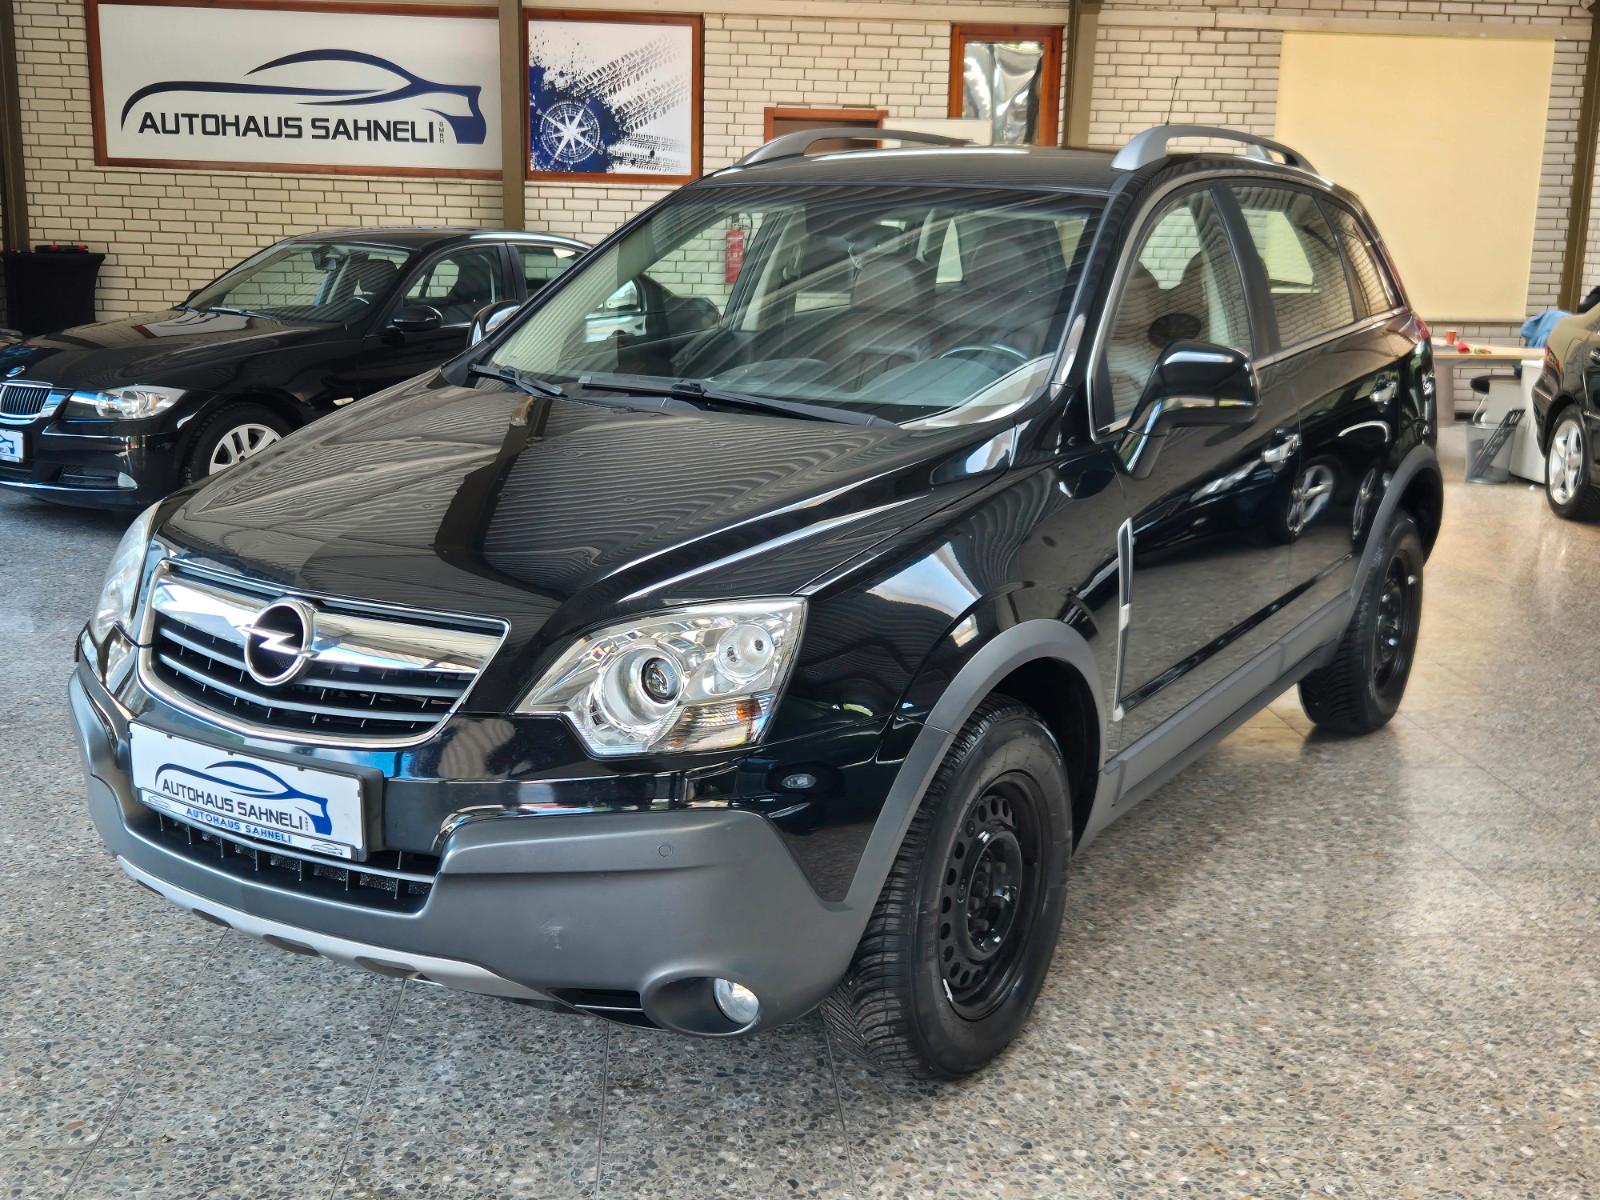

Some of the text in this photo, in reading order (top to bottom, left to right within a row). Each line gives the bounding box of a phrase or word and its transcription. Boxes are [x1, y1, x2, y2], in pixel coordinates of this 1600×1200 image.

[138, 111, 434, 144] AUTOHAUS SAHNELI
[162, 778, 234, 813] AUTOHAUS
[237, 801, 303, 830] SAHNELI
[186, 807, 292, 844] AUTOHAUS SAHNELI
